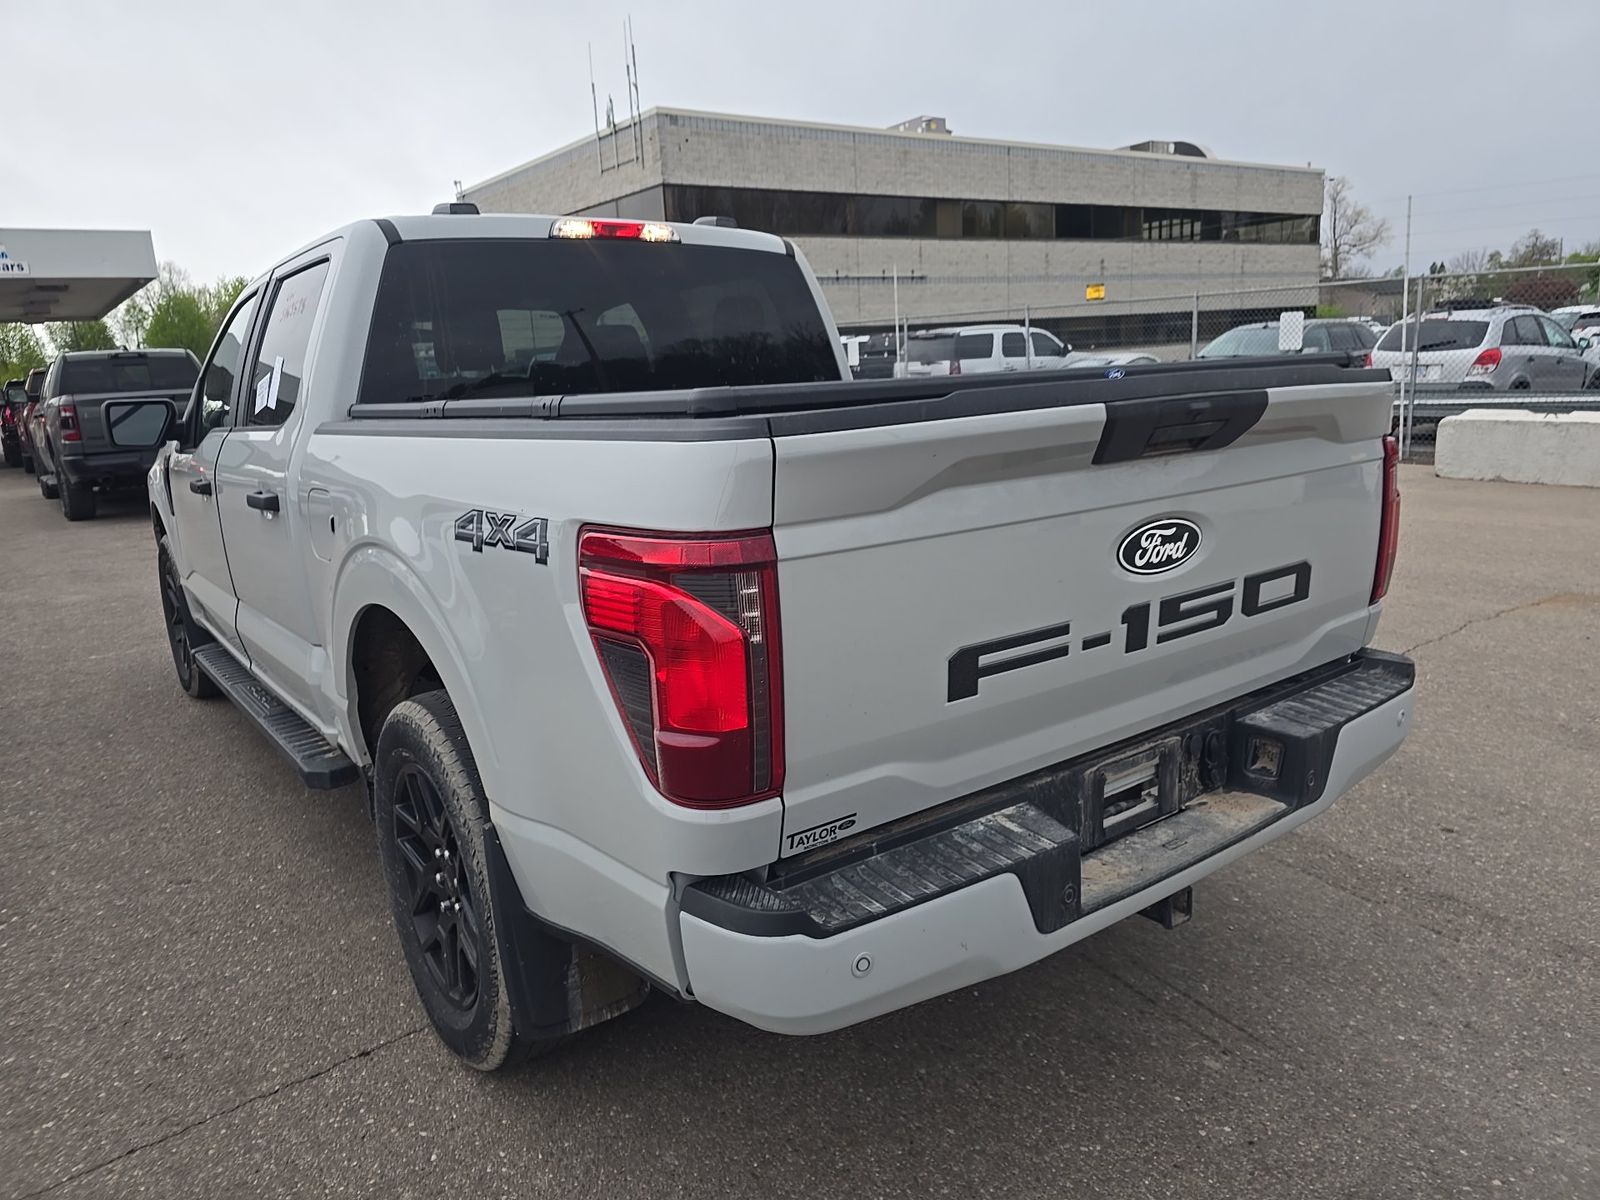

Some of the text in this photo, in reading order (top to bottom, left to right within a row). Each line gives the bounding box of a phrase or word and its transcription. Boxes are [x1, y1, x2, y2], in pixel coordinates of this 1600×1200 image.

[0, 262, 25, 272] ars
[1134, 525, 1188, 567] Ford
[946, 560, 1312, 703] F-150
[786, 824, 838, 850] TAYLOR
